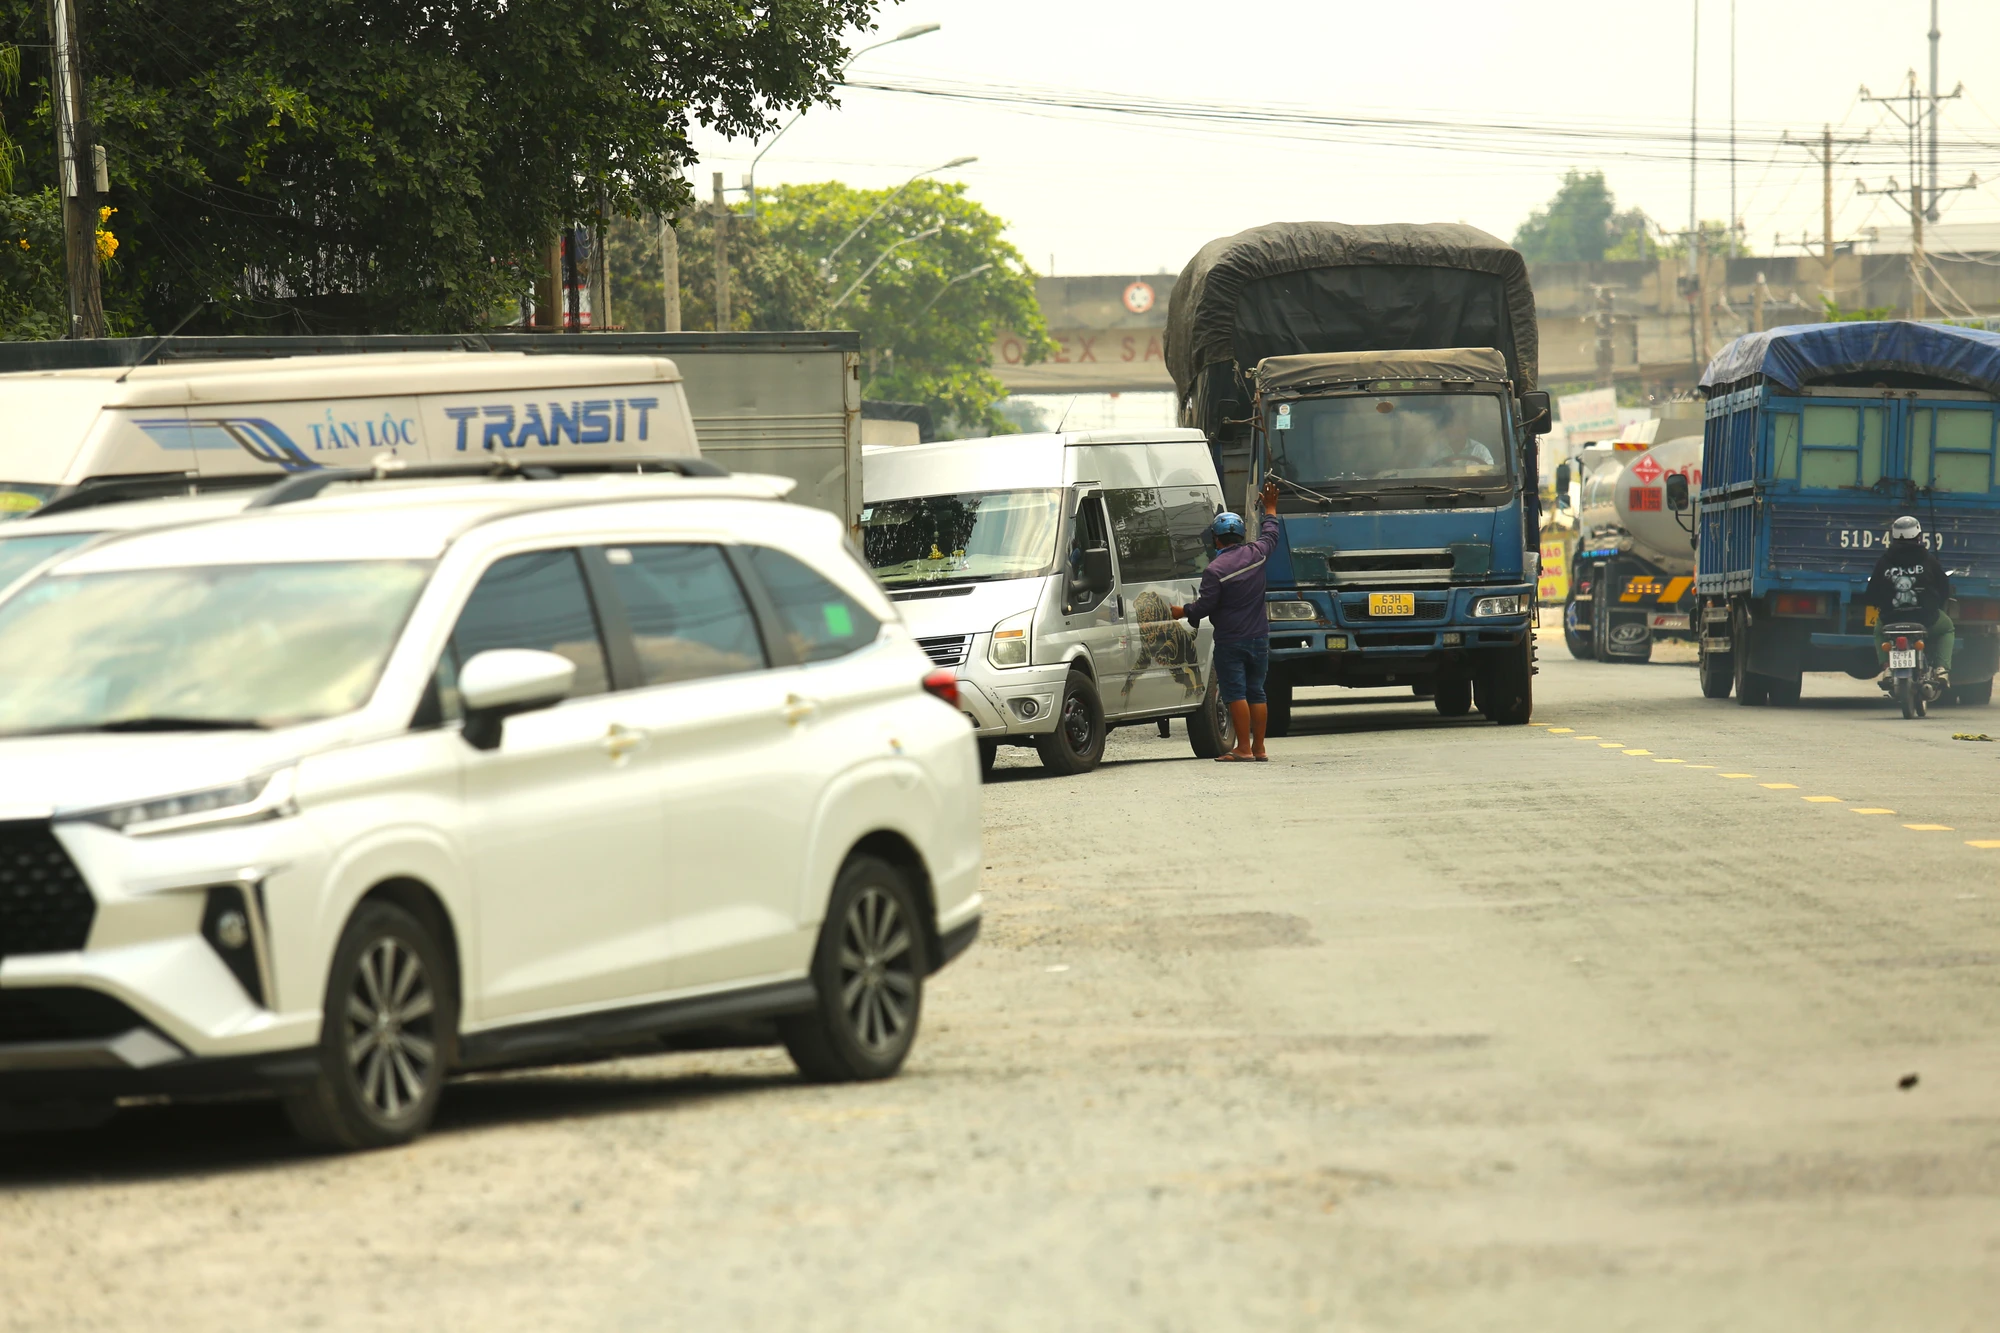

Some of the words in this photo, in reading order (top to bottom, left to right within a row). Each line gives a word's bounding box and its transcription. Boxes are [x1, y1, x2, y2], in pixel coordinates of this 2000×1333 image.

[443, 397, 659, 451] TRANSIT
[1381, 594, 1401, 604] 63H
[1374, 604, 1409, 614] 008.93
